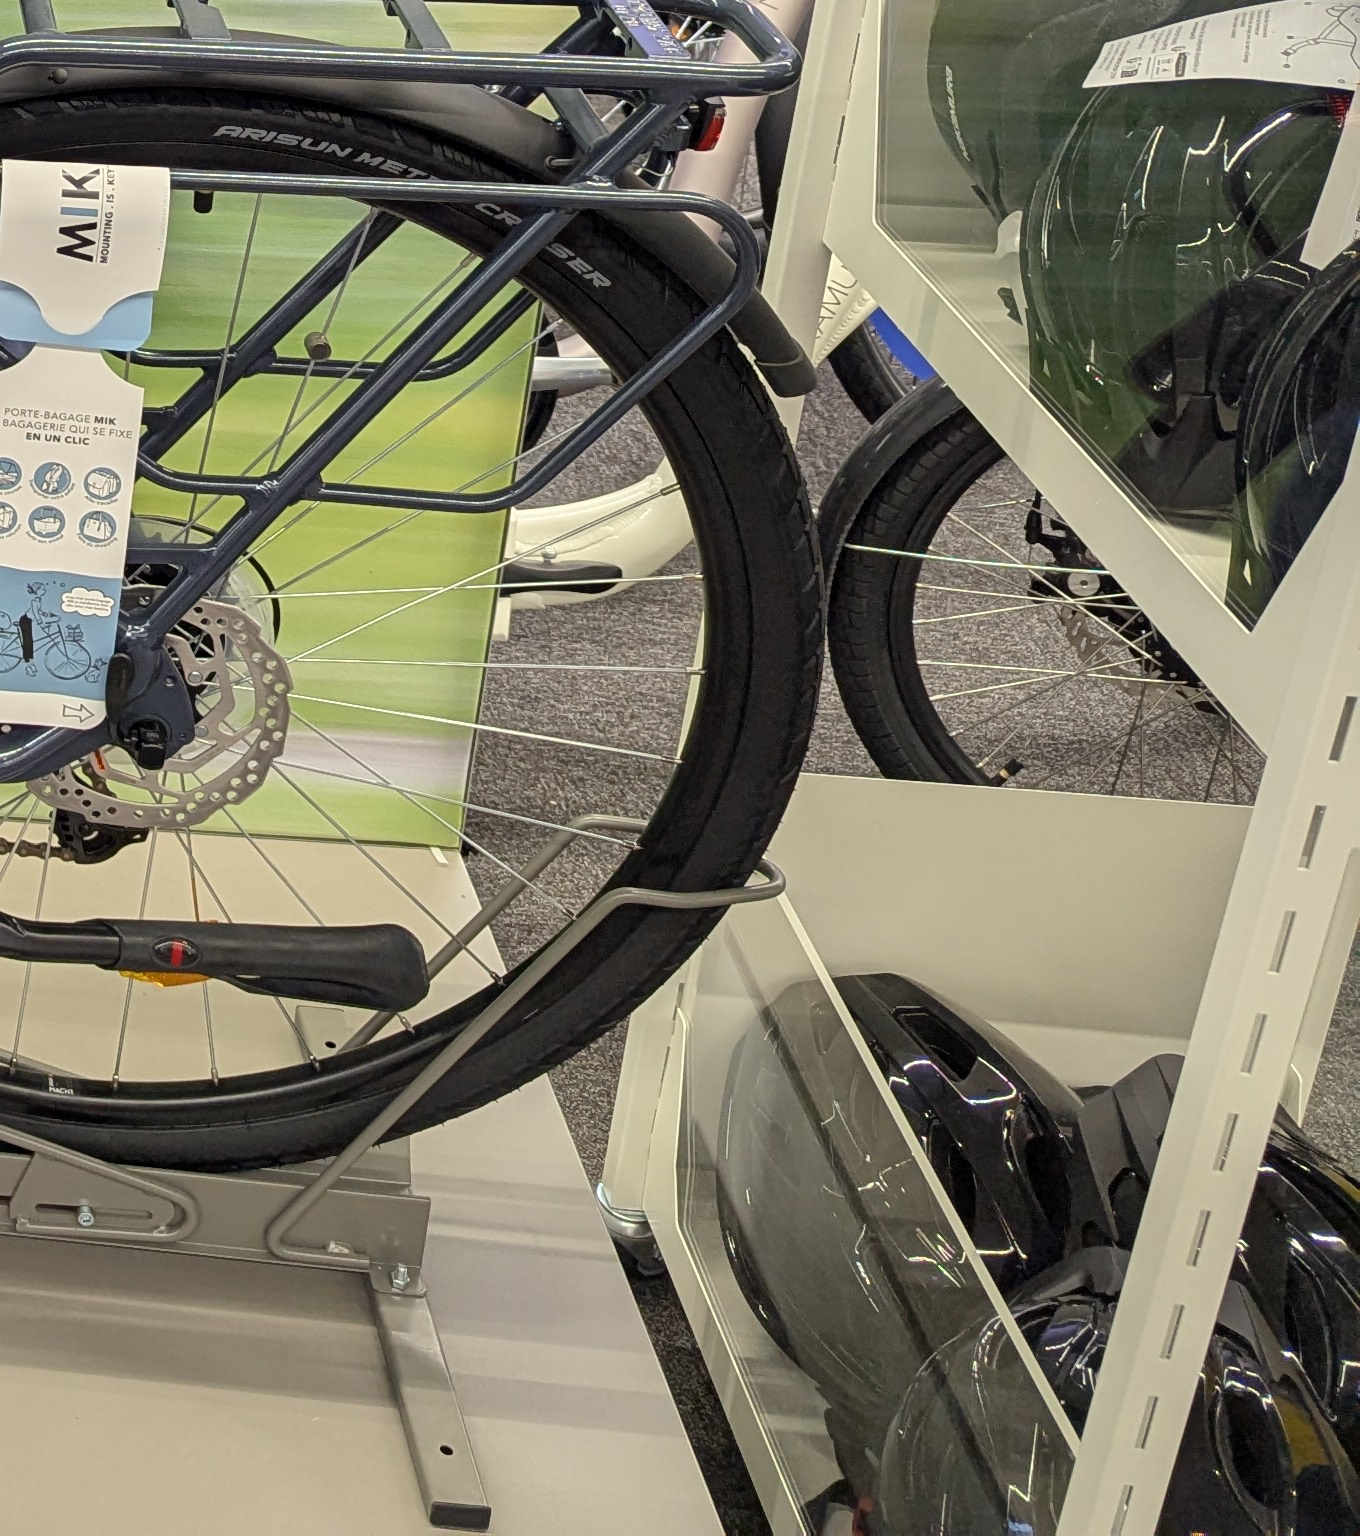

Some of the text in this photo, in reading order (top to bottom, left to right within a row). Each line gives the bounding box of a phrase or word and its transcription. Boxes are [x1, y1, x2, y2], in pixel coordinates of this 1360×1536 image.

[56, 168, 101, 263] MIK
[213, 124, 353, 159] ARISUN
[474, 202, 612, 290] CRSER
[99, 212, 114, 264] MOUNTING
[2, 419, 65, 432] BAGAGERIE
[68, 424, 90, 435] QUI
[93, 427, 106, 436] SE
[109, 428, 133, 439] FIXE
[4, 407, 117, 426] PORTE-BAGAGE MIK
[26, 432, 90, 446] EN UN CLIC
